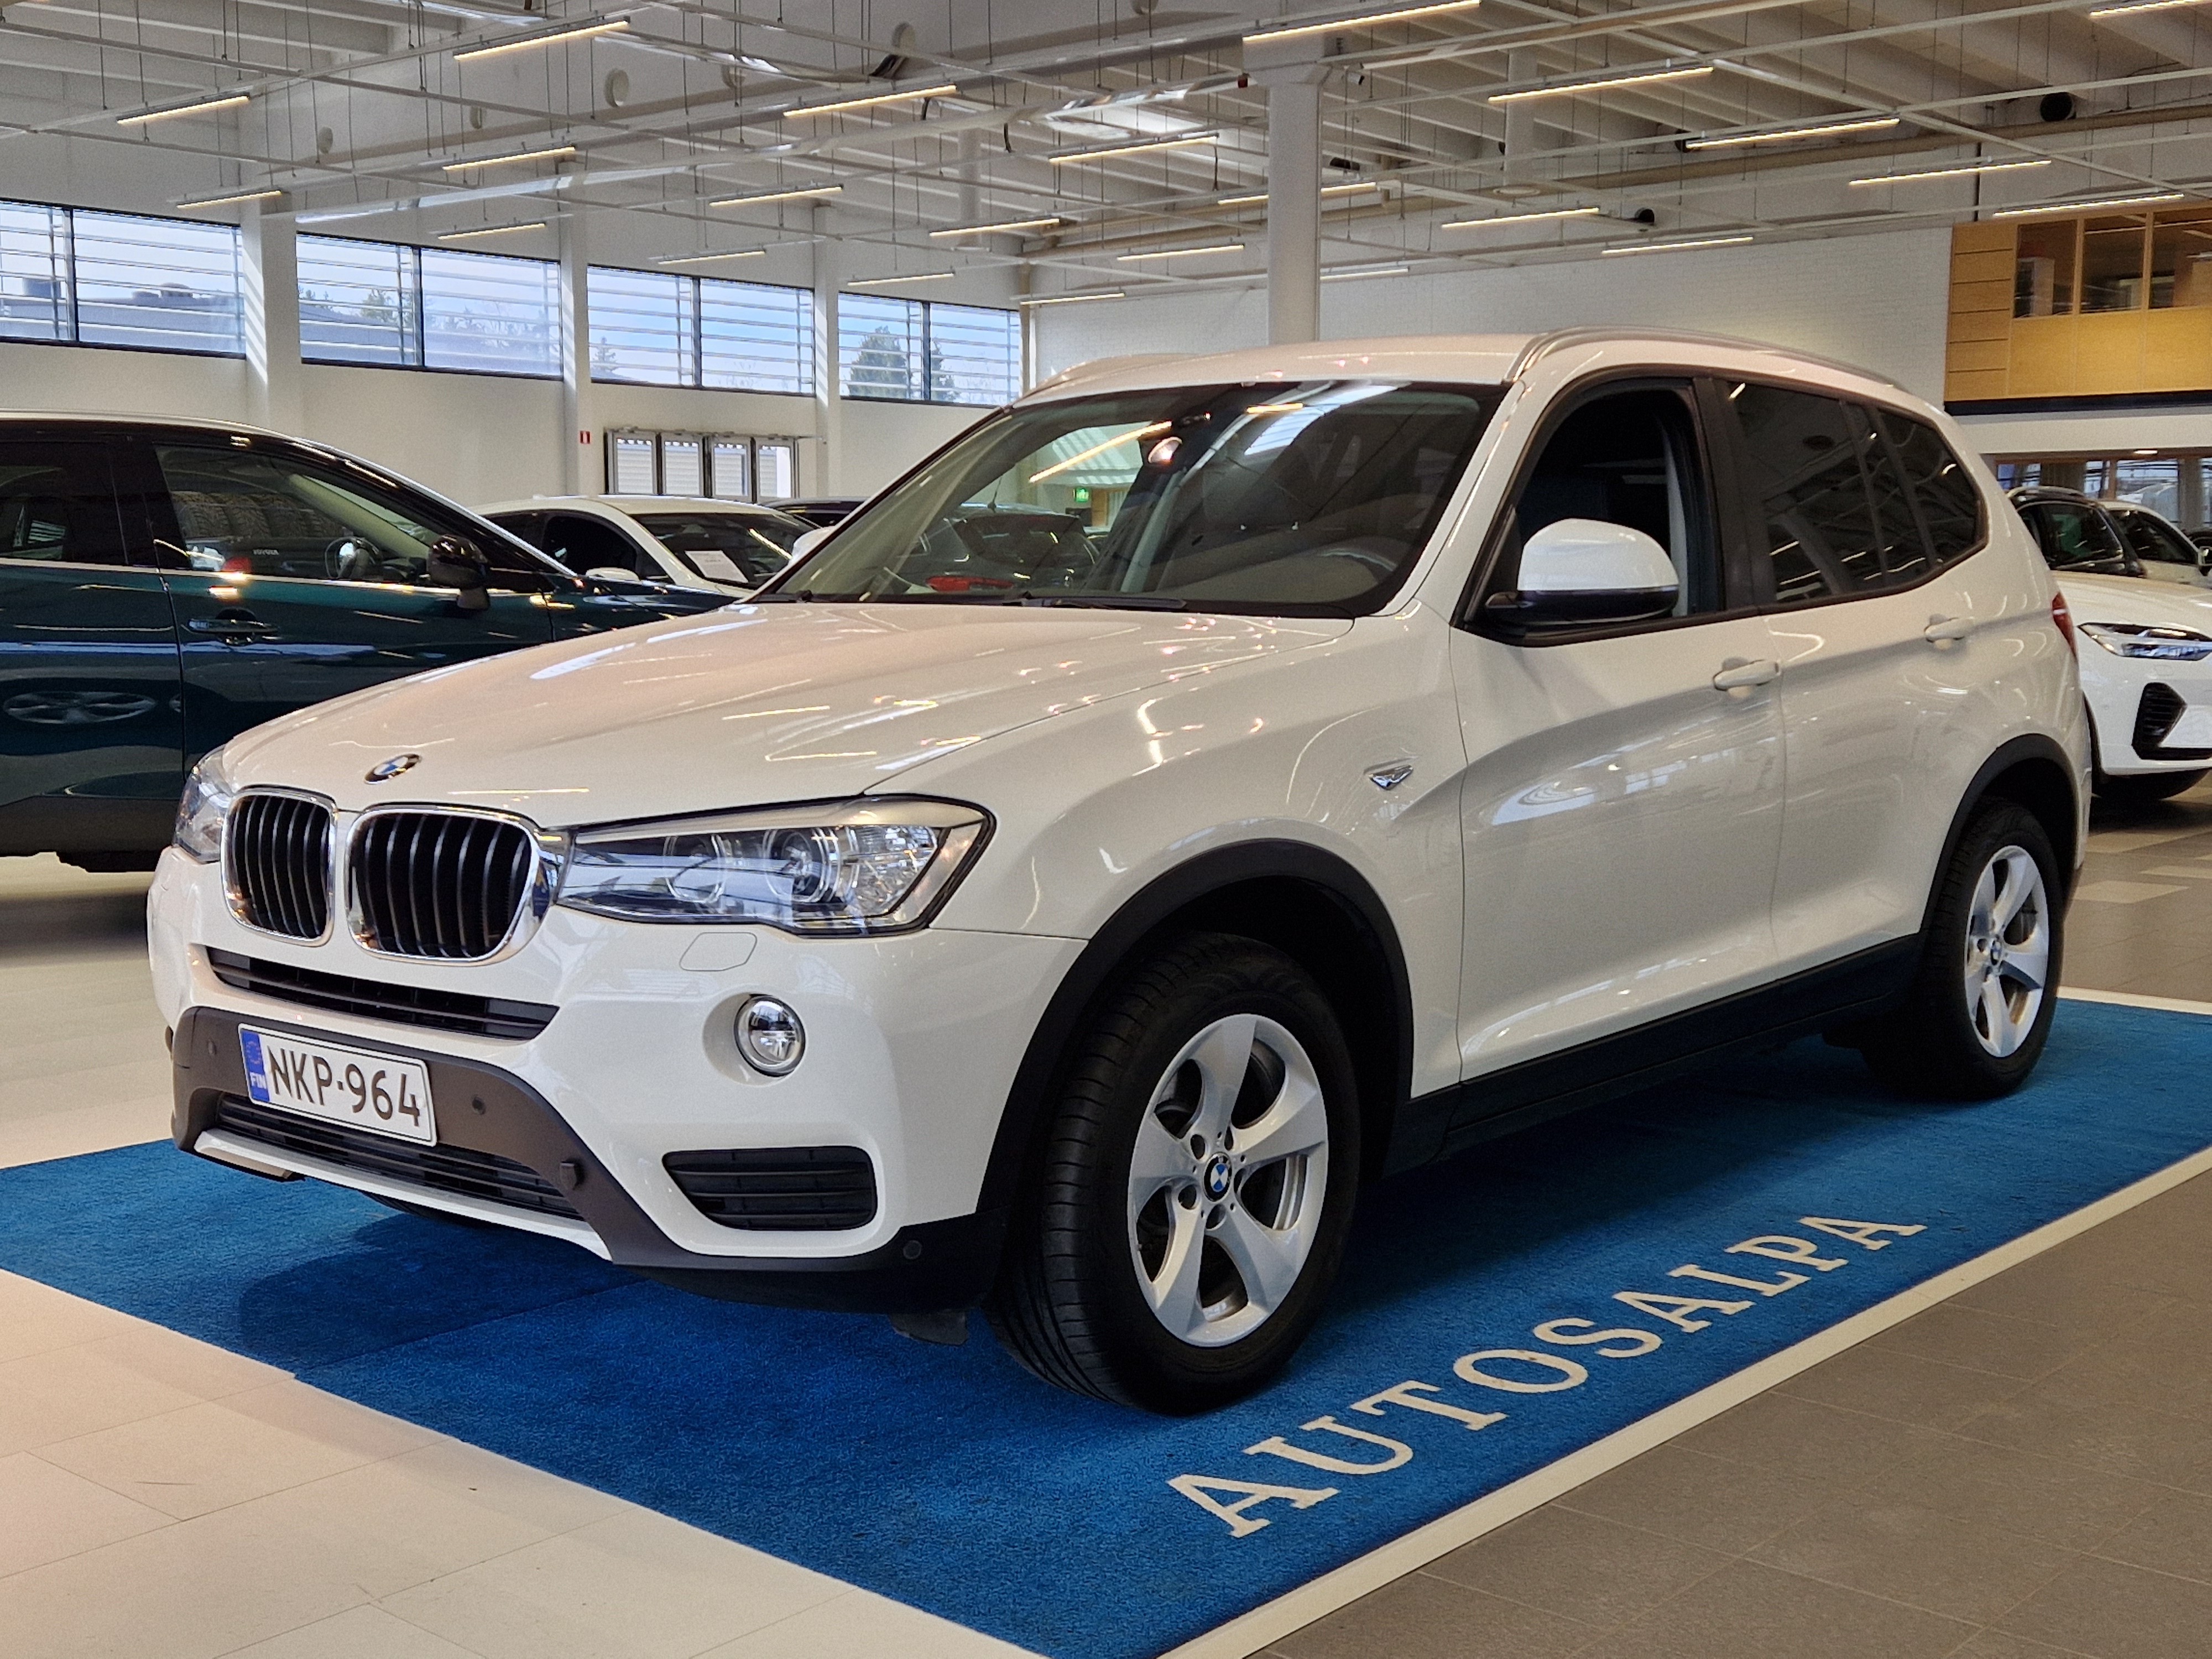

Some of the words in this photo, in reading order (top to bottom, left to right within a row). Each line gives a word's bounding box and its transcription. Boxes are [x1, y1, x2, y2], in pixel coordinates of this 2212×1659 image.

[249, 1072, 267, 1089] FIN
[268, 1046, 420, 1126] NKP-964
[1167, 1216, 1927, 1538] AUTOSALPA
